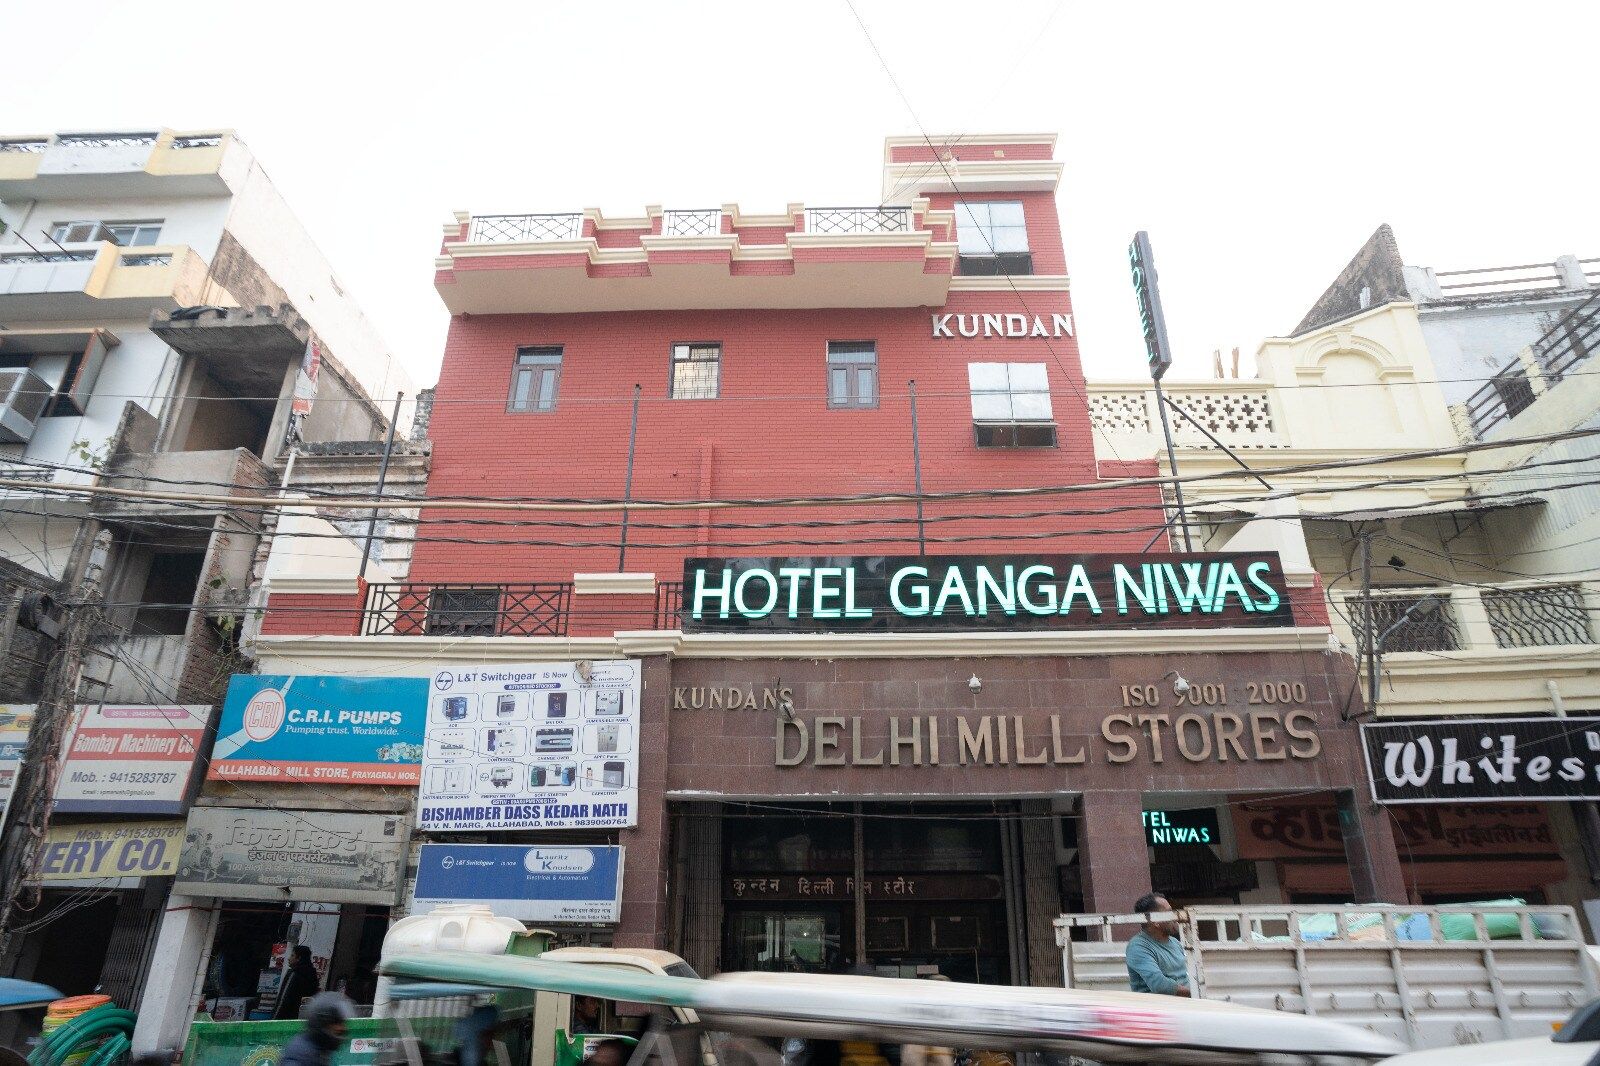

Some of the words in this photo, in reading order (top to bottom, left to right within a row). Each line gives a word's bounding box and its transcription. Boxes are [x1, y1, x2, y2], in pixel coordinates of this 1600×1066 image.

[931, 313, 1073, 338] KUNDAN
[692, 567, 873, 619] HOTEL
[889, 564, 1102, 617] GANGA
[1113, 561, 1280, 616] NIWAS
[458, 673, 478, 682] L&T
[481, 672, 537, 682] Switchgear
[674, 687, 794, 710] KUNDANS
[1121, 685, 1160, 707] ISO
[1174, 682, 1227, 706] 9001
[1246, 681, 1307, 704] 2000
[249, 701, 280, 729] CRI
[287, 709, 334, 725] C.R.I.
[338, 710, 402, 725] PUMPS
[285, 725, 325, 735] Pumping
[327, 726, 350, 735] trust.
[352, 726, 400, 736] Worldwide.
[775, 716, 939, 766] DELHI
[957, 714, 1085, 766] MILL
[1101, 709, 1321, 764] STORES
[74, 733, 120, 755] Bombay
[119, 733, 179, 756] Machinery
[178, 734, 195, 754] Co.
[1384, 734, 1586, 787] Whites
[70, 772, 98, 782] Mob.
[108, 772, 177, 784] 9415283787
[216, 765, 280, 776] ALLAHABAD
[286, 766, 310, 777] MILL
[313, 766, 350, 780] STORE,
[351, 770, 396, 780] PRAYAGRAJ
[421, 806, 501, 821] BISHAMBER
[504, 805, 540, 819] DASS
[544, 804, 589, 818] KEDAR
[592, 803, 628, 817] NATH
[1141, 811, 1171, 827] TEL
[485, 820, 543, 828] ALLAHABAD,
[75, 830, 103, 840] Mob.
[114, 827, 183, 840] 9415283787
[1152, 827, 1210, 844] NIWAS
[117, 838, 171, 872] CO.
[536, 851, 568, 860] Lauritz
[542, 861, 583, 870] Knudsen
[733, 878, 780, 896] कुन्दन
[798, 877, 834, 895] दिल्ली
